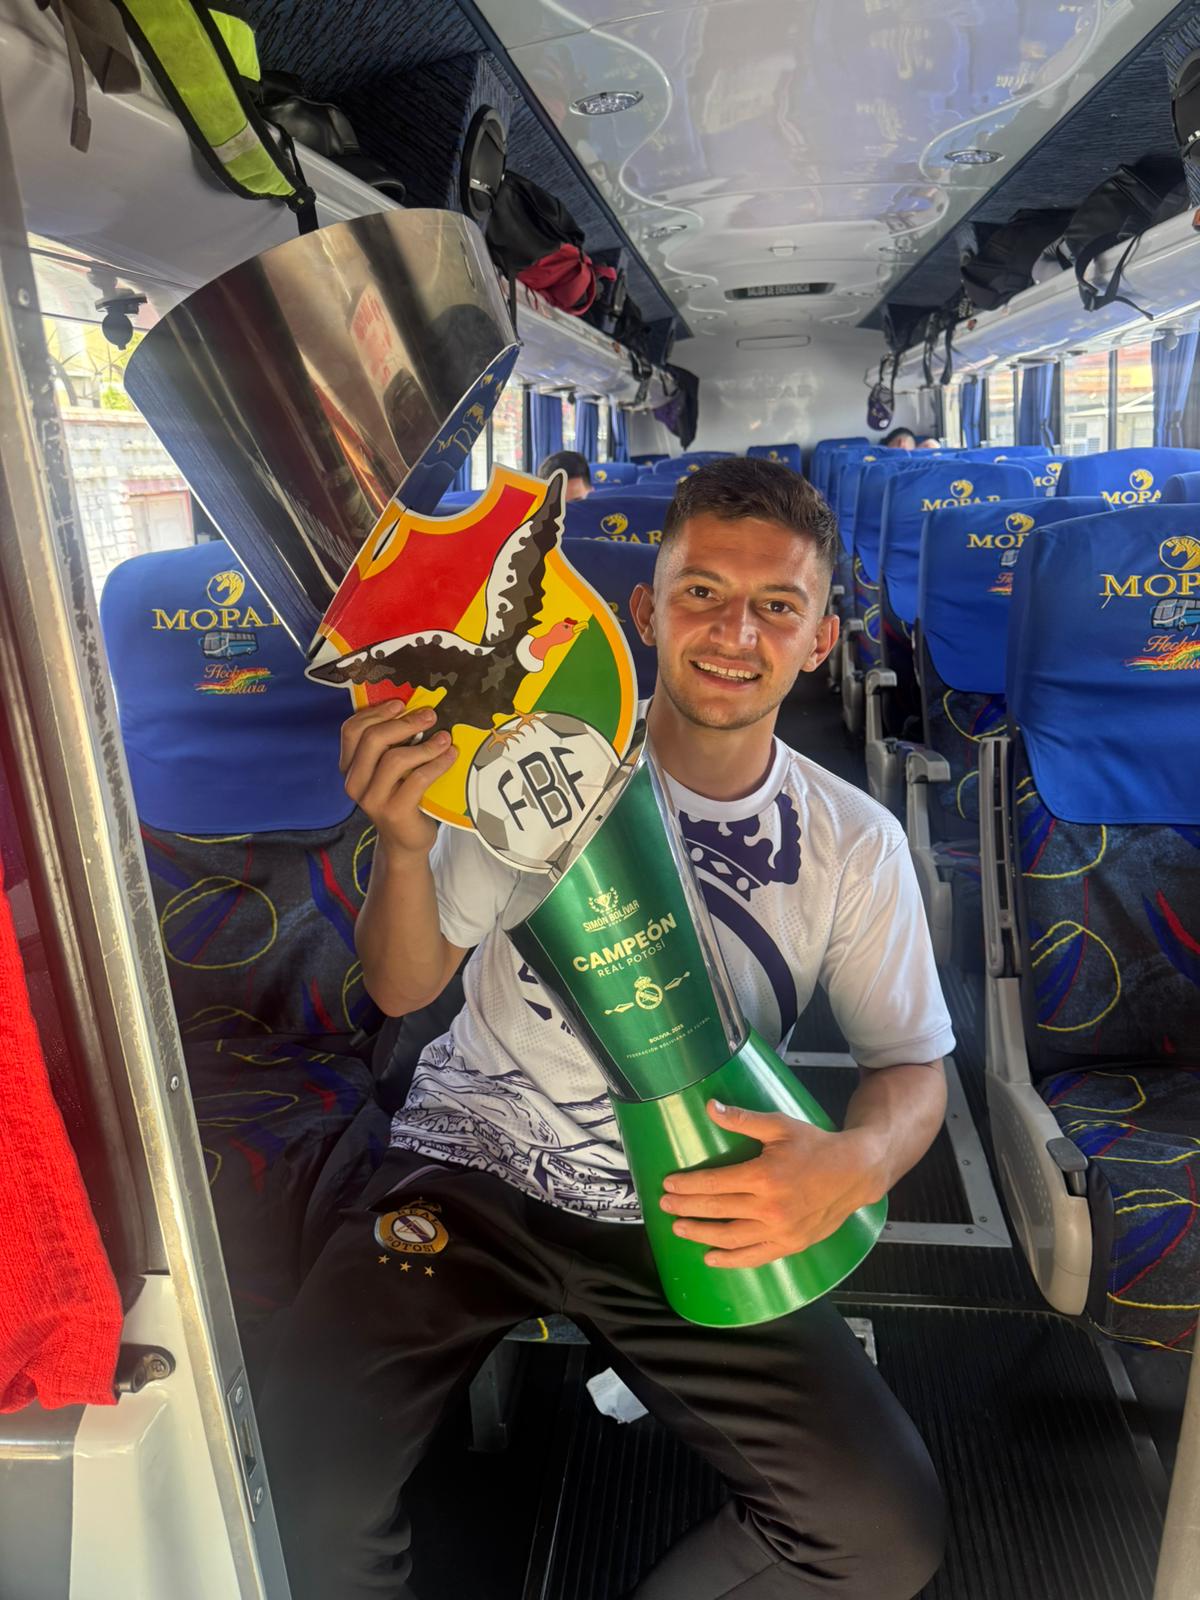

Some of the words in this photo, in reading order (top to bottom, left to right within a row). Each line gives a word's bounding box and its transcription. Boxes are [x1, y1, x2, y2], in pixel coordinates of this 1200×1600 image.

[498, 747, 585, 831] FBF
[572, 912, 678, 972] CAMPEÓN
[597, 963, 625, 977] REAL
[626, 939, 666, 966] POTOSÍ
